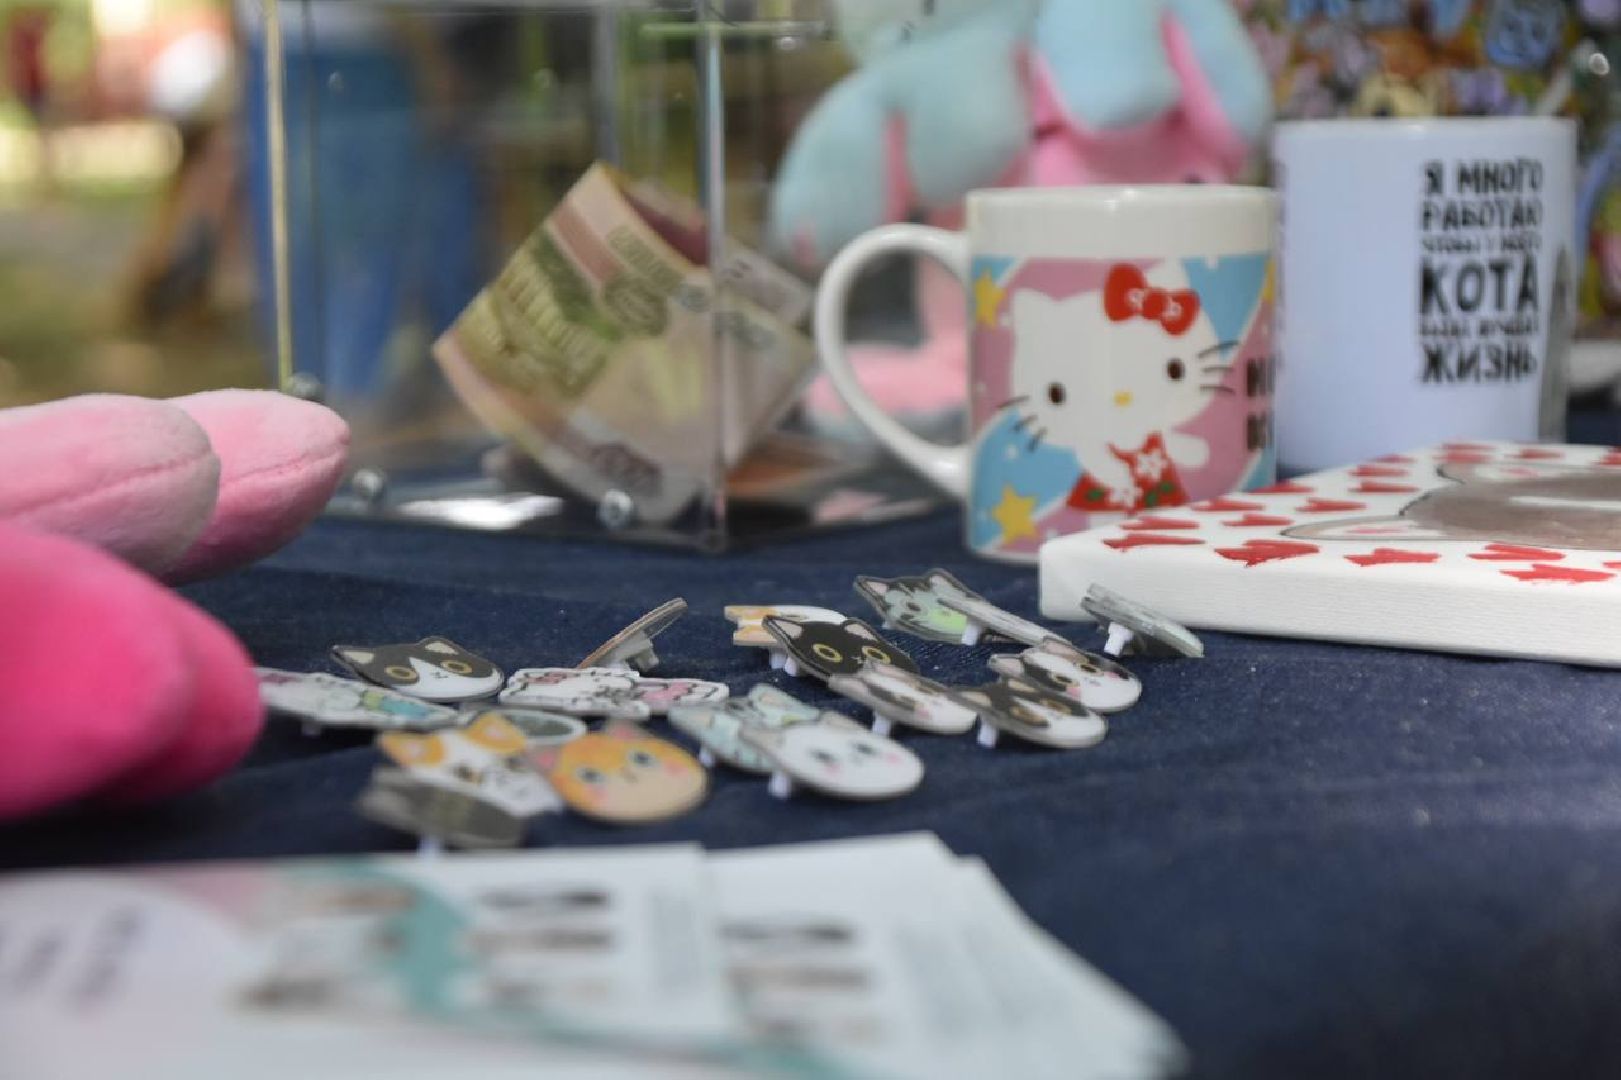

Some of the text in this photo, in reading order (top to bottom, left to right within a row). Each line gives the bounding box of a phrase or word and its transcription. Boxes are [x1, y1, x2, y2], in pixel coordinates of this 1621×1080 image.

[1422, 158, 1543, 194] Я МНОГО
[1420, 253, 1538, 314] КОТА
[1422, 344, 1537, 383] ЖИЗНЬ
